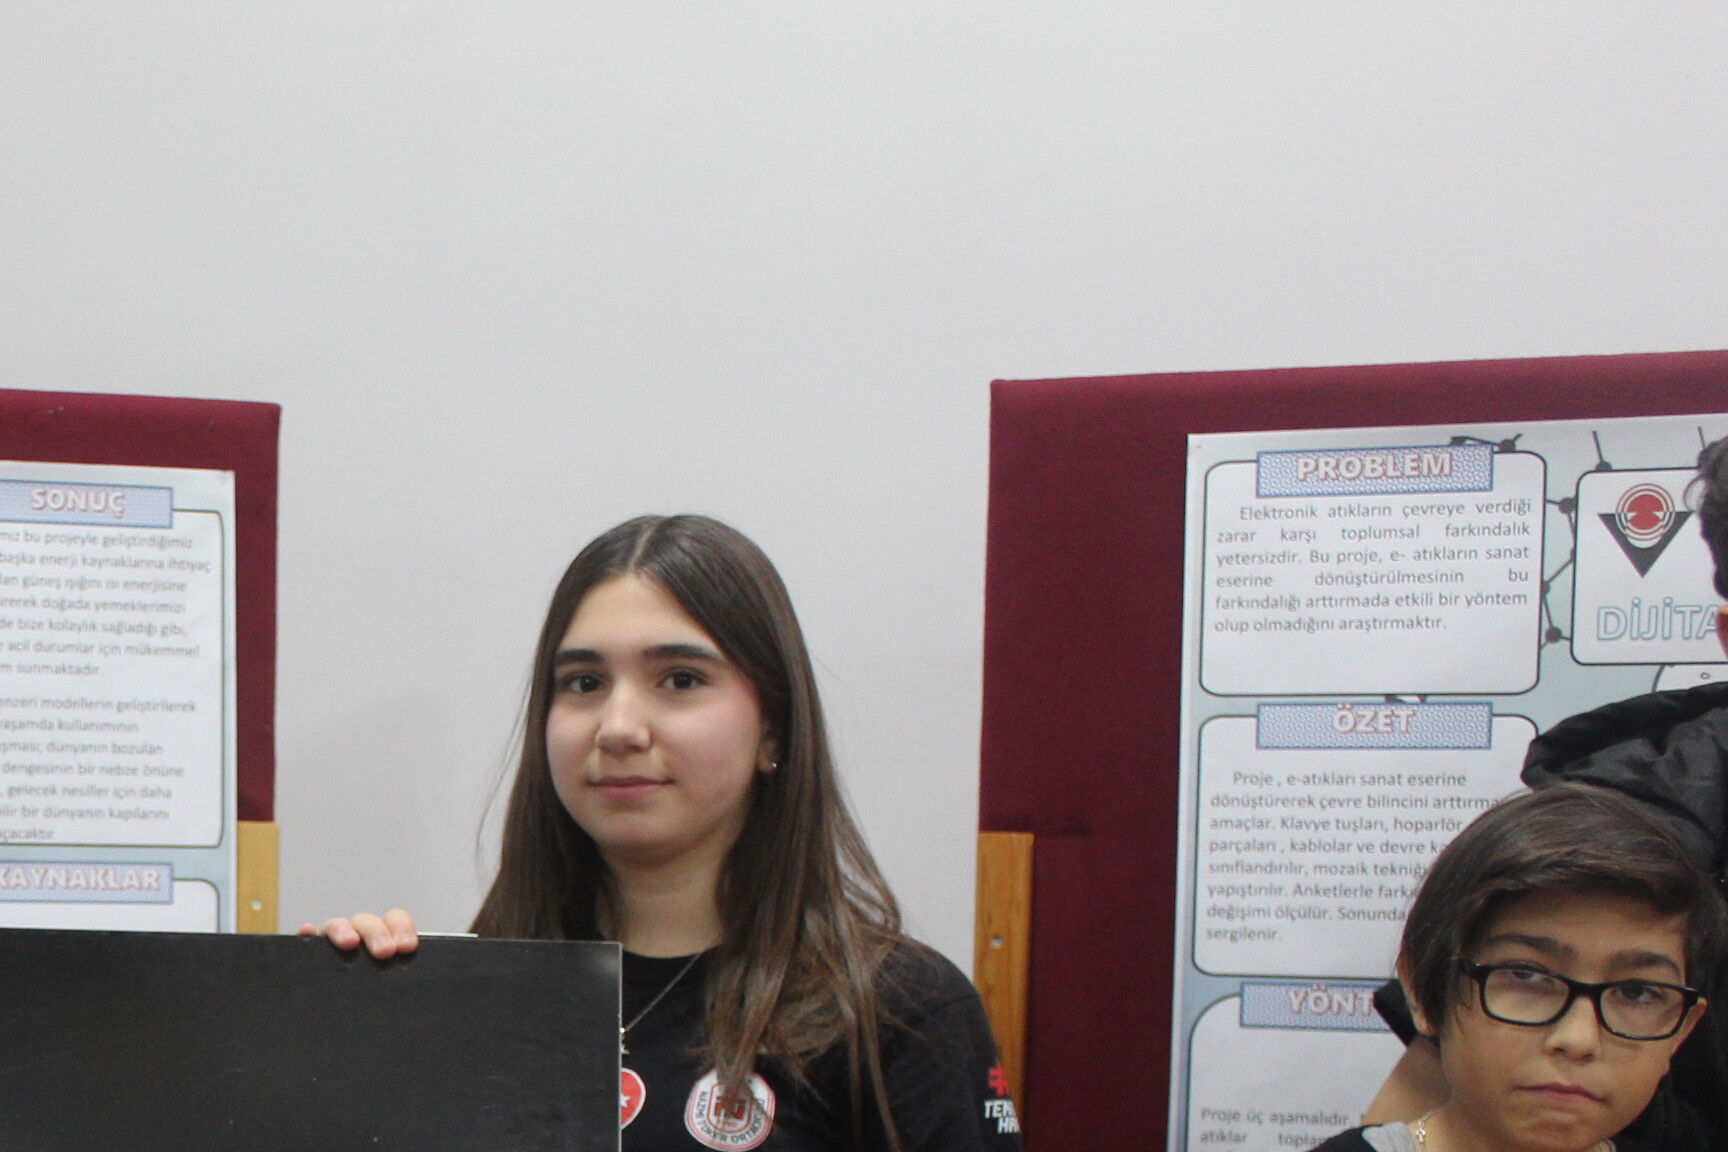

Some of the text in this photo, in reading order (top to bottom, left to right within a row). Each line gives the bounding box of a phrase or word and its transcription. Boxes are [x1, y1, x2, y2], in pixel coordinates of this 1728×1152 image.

[1297, 452, 1453, 482] PROBLEM
[31, 488, 125, 518] SONUÇ
[1240, 499, 1532, 521] Elektronik atıkların çevreye verdiği
[1216, 522, 1530, 545] zarar karşı toplumsal farkındalık
[1216, 549, 1300, 568] yetersizdir.
[1310, 548, 1328, 563] Bu
[1336, 547, 1381, 566] proje,
[1414, 545, 1476, 561] atıkların
[1486, 546, 1528, 560] sanat
[1216, 568, 1528, 590] eserine dönüştürülmesinin bu
[1214, 591, 1528, 613] farkındalığı arttırmada etkili bir yöntem
[1214, 614, 1446, 636] olup olmadığını araştırmaktır.
[1597, 596, 1719, 641] DİJİTA
[1333, 704, 1416, 734] ÖZET
[1434, 796, 1502, 809] arttırma
[1289, 984, 1374, 1016] YÖNT
